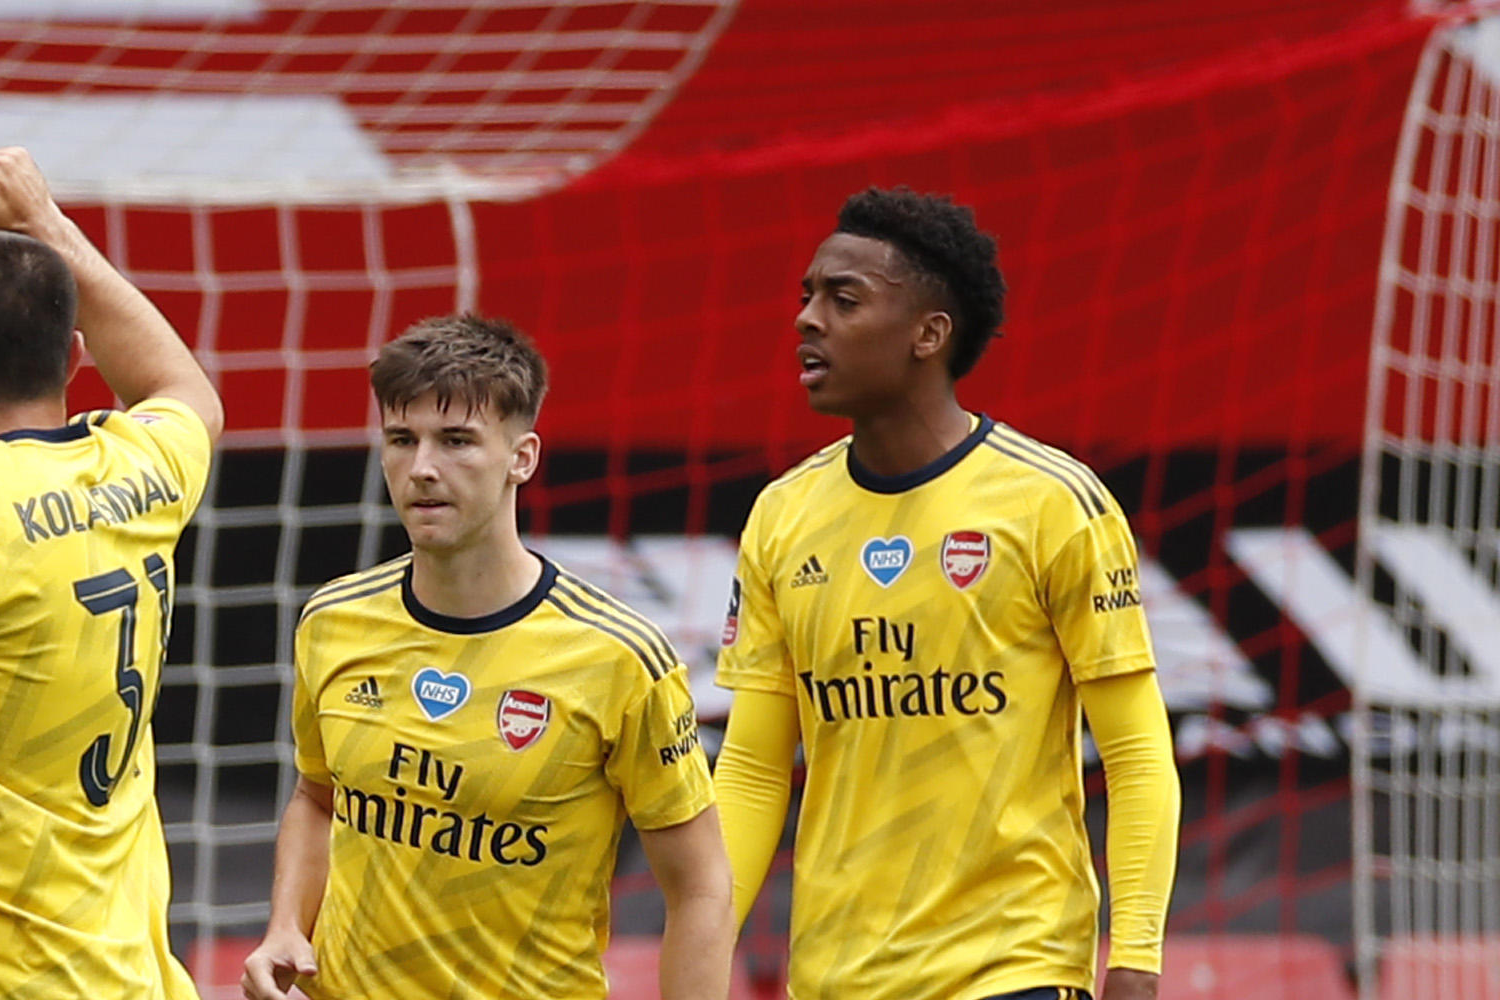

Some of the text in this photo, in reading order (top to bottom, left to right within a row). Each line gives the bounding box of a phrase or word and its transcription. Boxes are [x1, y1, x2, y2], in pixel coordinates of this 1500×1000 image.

[947, 537, 986, 552] Arsenal
[870, 550, 904, 568] NHS
[790, 573, 829, 588] adidas
[853, 616, 915, 662] Fly
[344, 692, 384, 709] adidas
[421, 684, 456, 702] NHS
[504, 696, 548, 713] Arsenal
[388, 742, 464, 800] Fly
